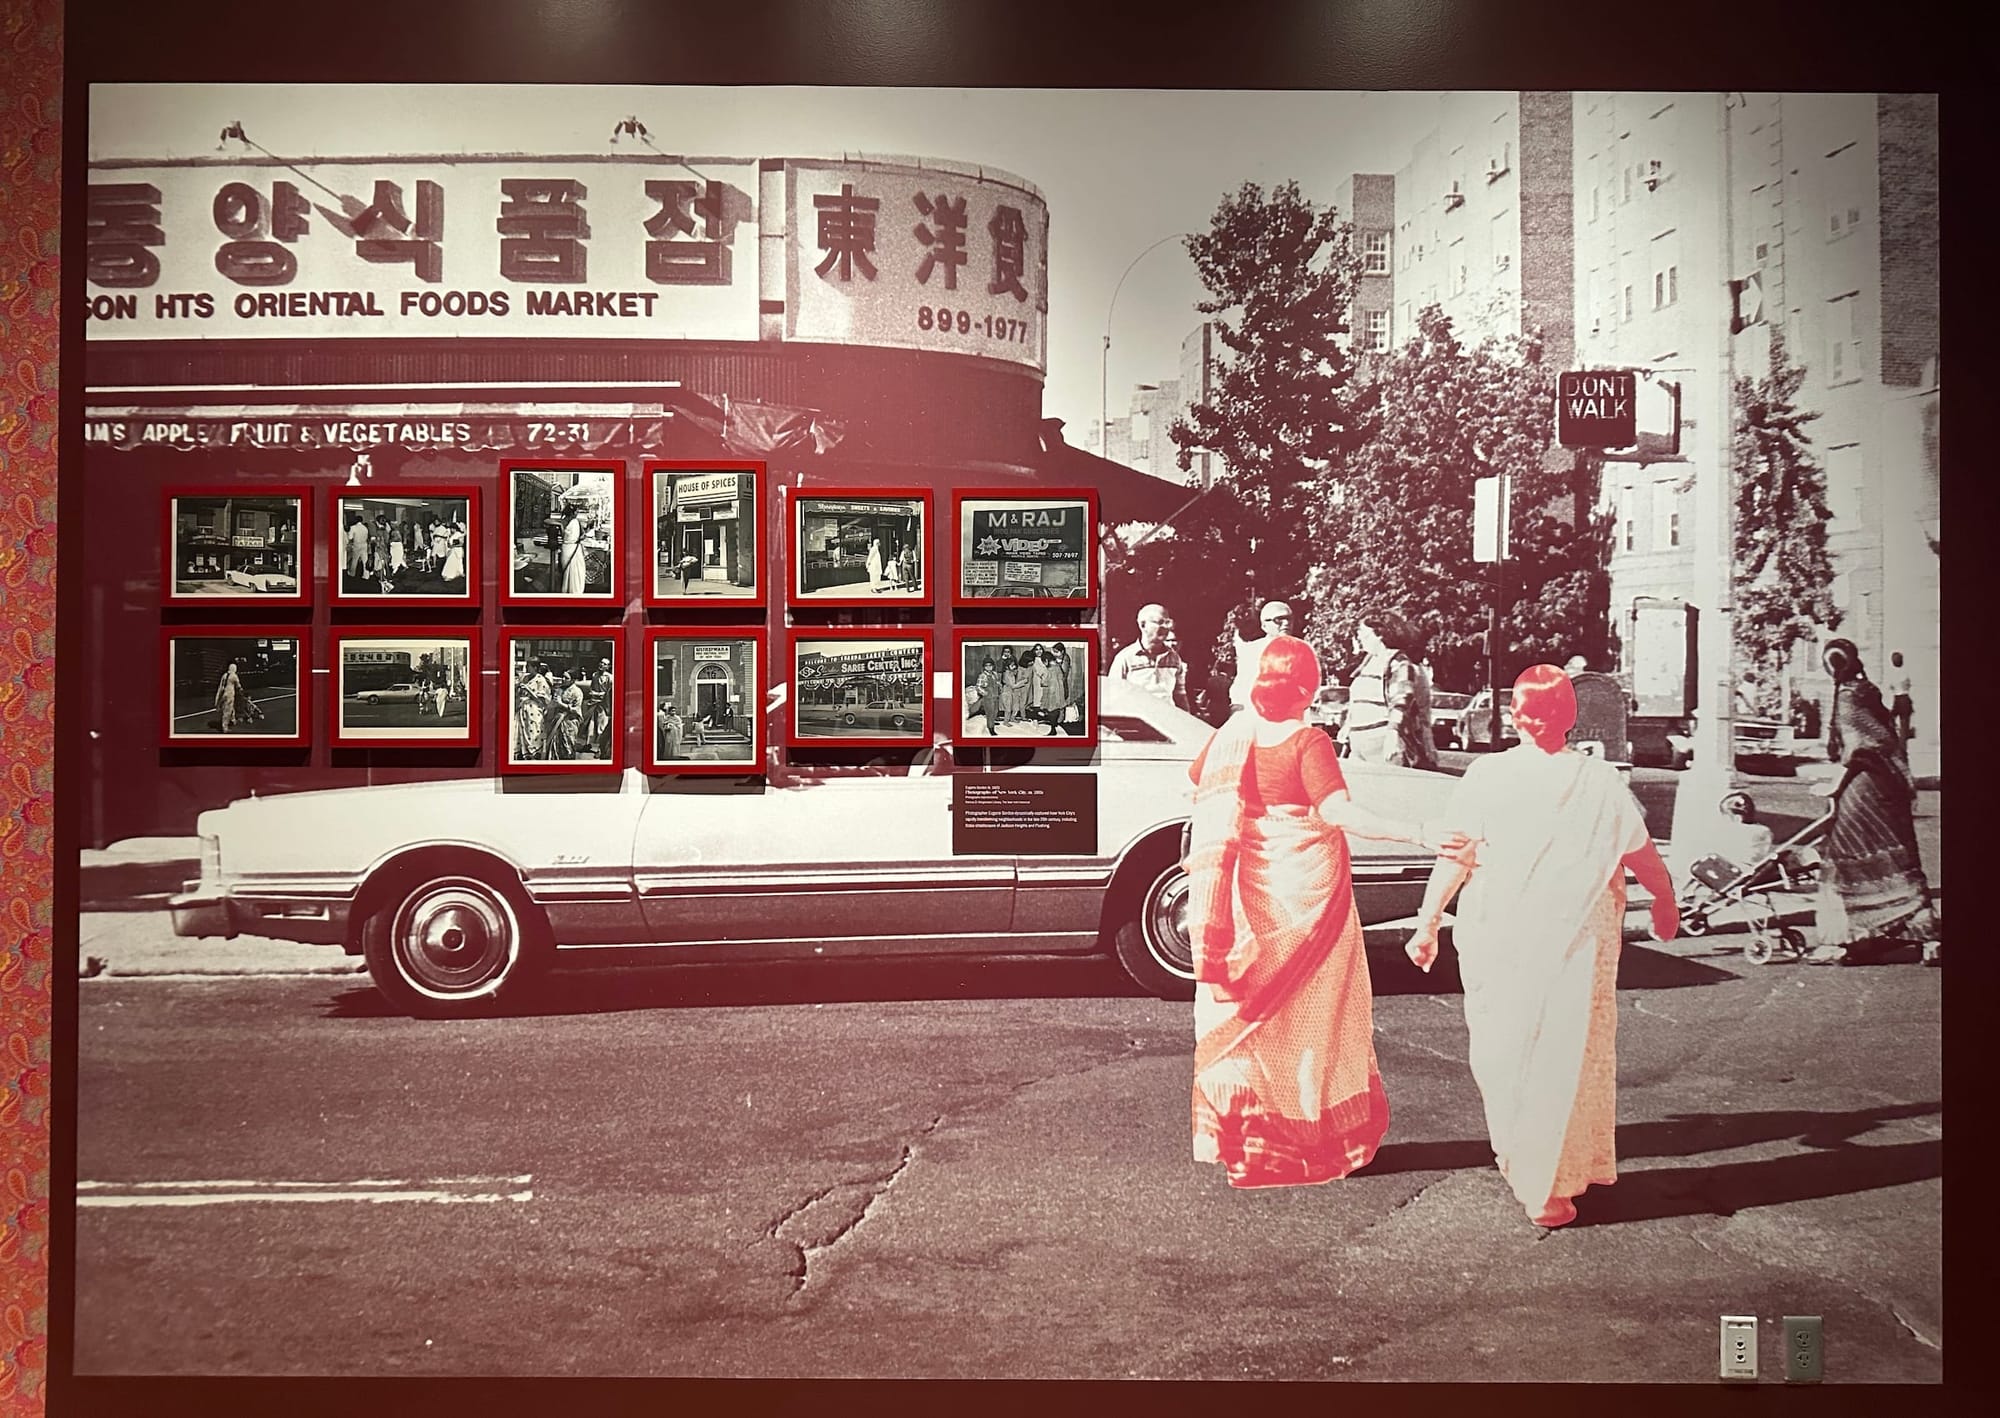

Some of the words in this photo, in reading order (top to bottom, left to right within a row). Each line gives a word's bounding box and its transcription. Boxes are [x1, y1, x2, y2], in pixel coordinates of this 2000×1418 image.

[155, 293, 215, 319] HTS
[234, 291, 384, 318] ORIENTAL
[400, 291, 510, 318] FOODS
[526, 291, 659, 318] MARKET
[918, 305, 1028, 344] 899-1977
[1566, 376, 1629, 397] DONT
[1566, 399, 1628, 419] WALK
[142, 422, 209, 443] APPLE
[230, 422, 292, 446] FRUIT
[299, 425, 317, 444] &
[323, 422, 472, 444] VEGETABLES
[527, 422, 590, 443] 72-31
[678, 482, 699, 493] HOUSE
[701, 481, 710, 490] OF
[711, 477, 736, 489] SPICES
[988, 512, 1007, 528] M
[1010, 513, 1019, 524] &
[1022, 510, 1066, 527] RAJ
[841, 663, 865, 673] SAREE
